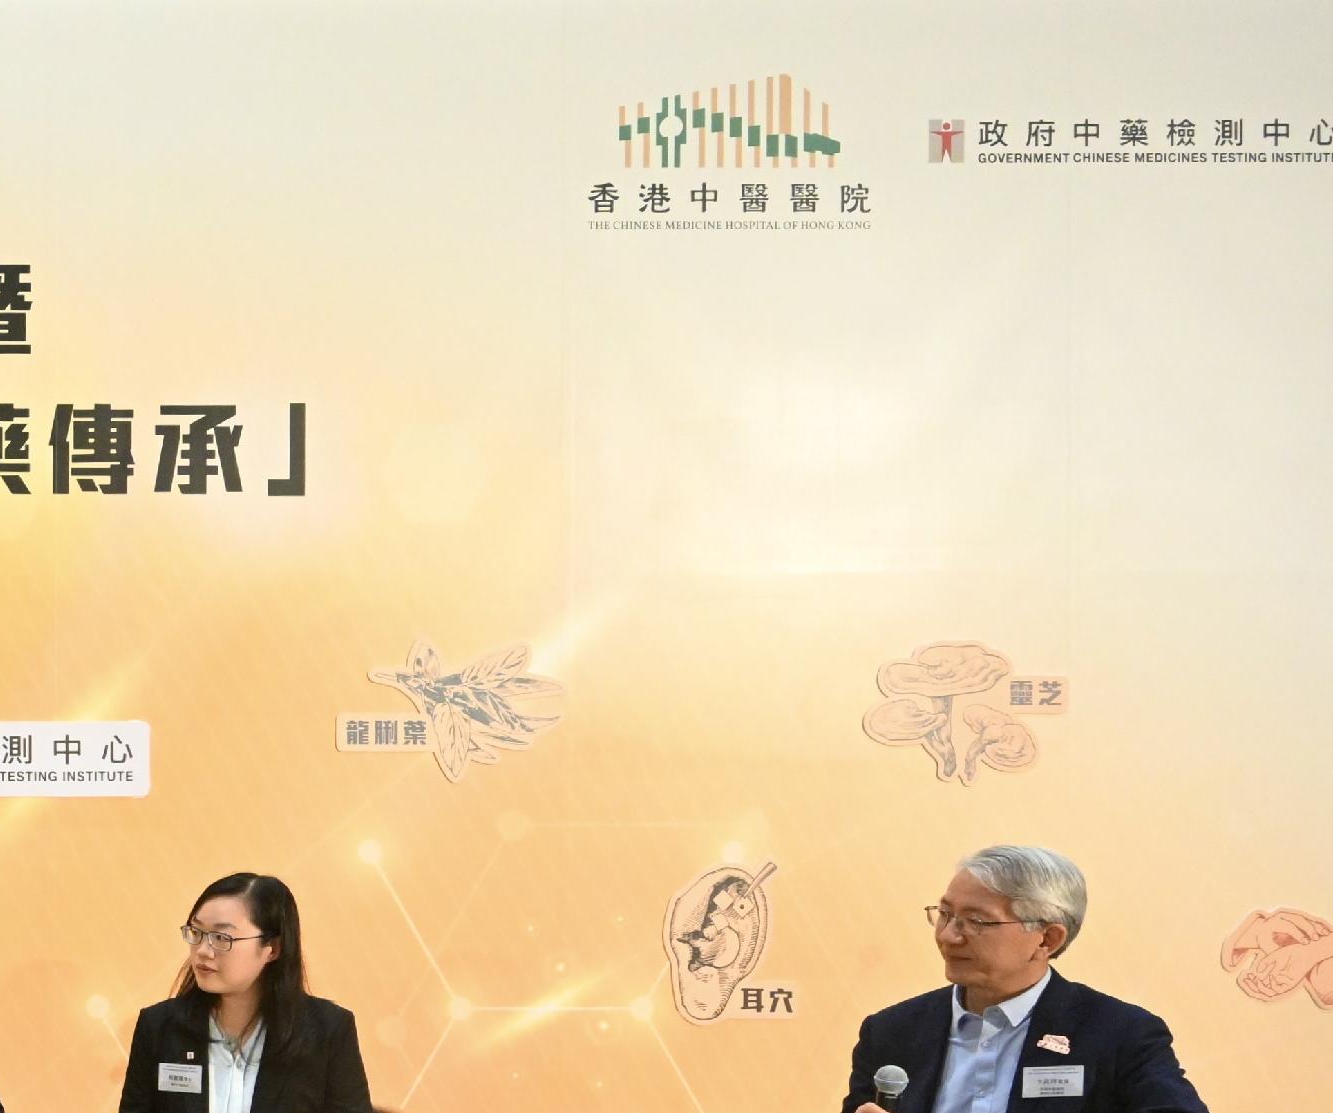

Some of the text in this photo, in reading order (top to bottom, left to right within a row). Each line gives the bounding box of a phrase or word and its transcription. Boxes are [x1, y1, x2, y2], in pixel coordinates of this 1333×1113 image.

[978, 118, 1333, 147] 政府中藥檢測中心
[978, 152, 1333, 163] GOVERNMENT CHINESE MEDICINES TESTING INSTITUT
[588, 182, 872, 214] 香港中醫醫院
[589, 220, 871, 230] THE CHINESE MEDICINE HOSPITAL OF HONG KONG
[1009, 680, 1062, 706] 靈芝
[346, 720, 427, 745] 龍脷葉
[0, 770, 57, 782] TESTING
[62, 770, 133, 782] INSTITUTE
[741, 988, 793, 1013] 耳穴
